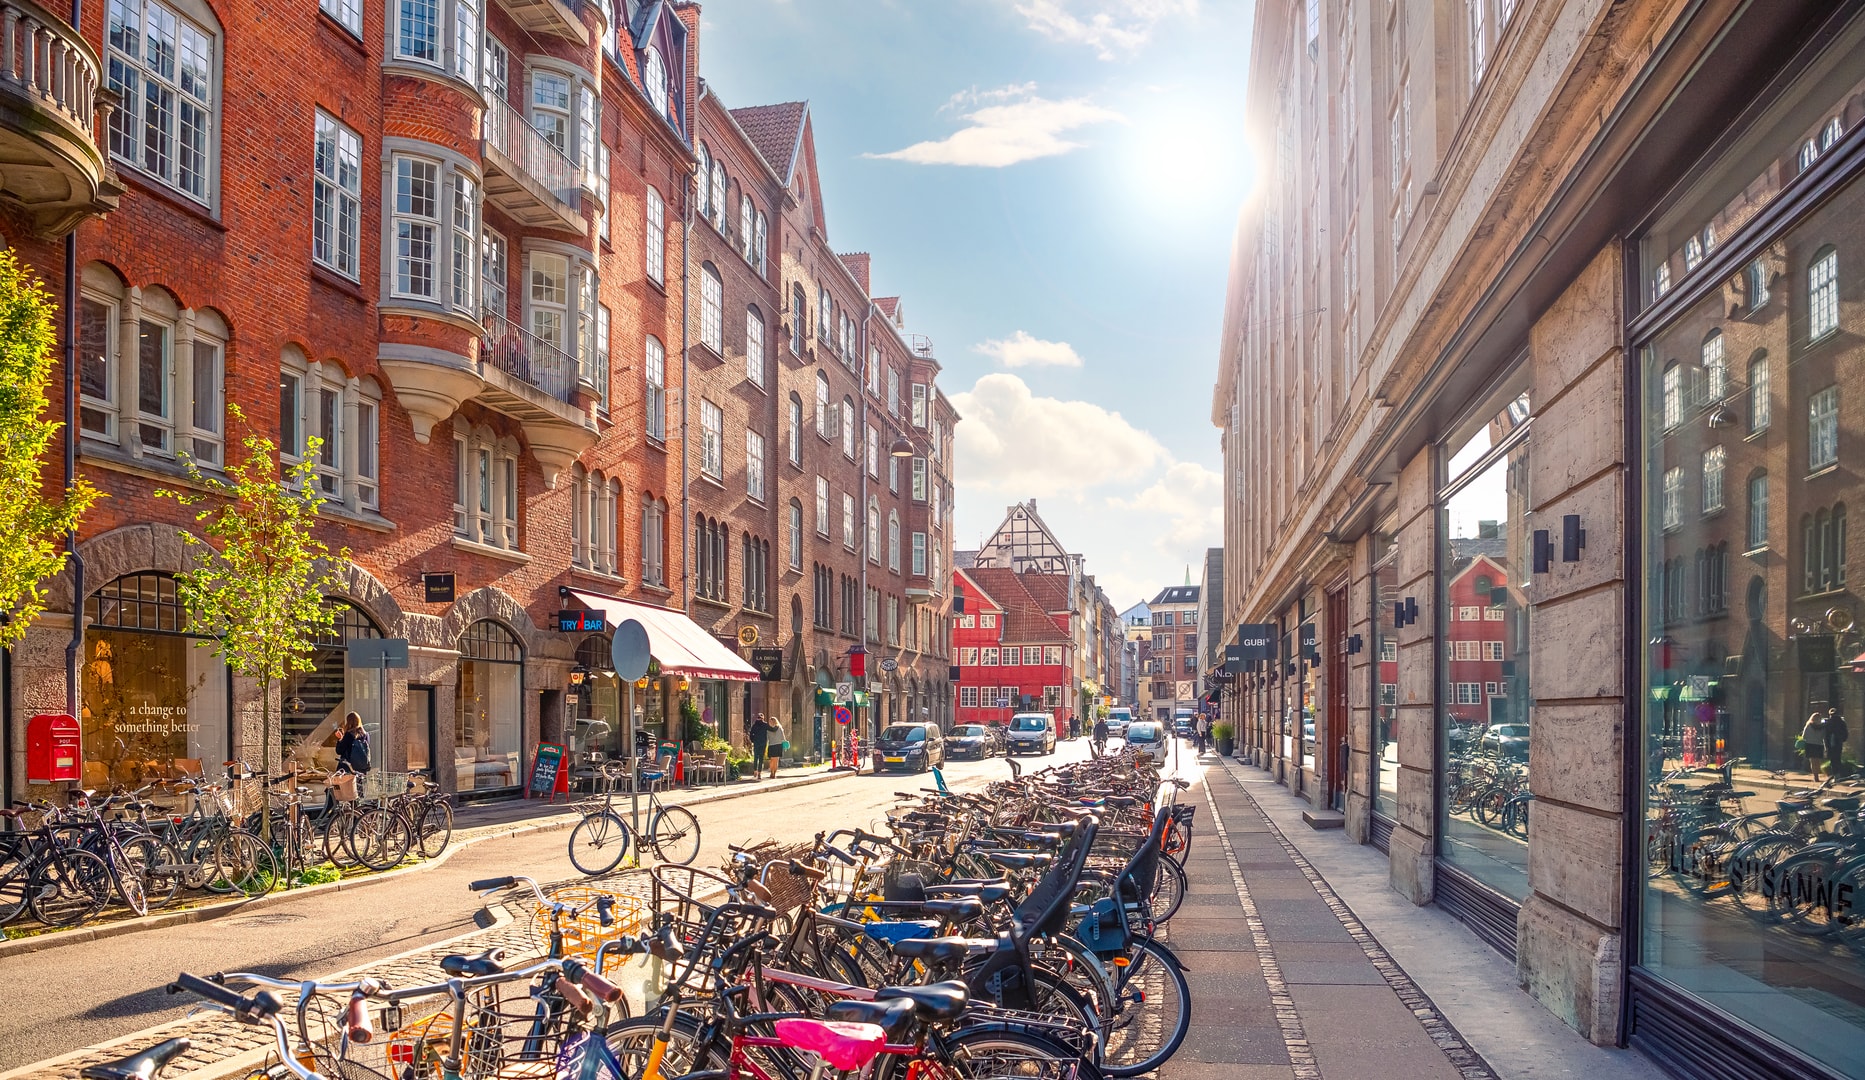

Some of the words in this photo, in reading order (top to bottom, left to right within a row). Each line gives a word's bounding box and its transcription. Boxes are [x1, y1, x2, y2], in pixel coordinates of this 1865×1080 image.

[1244, 638, 1265, 646] GUBI
[130, 707, 136, 715] a
[138, 701, 174, 719] change
[176, 706, 186, 715] to
[114, 719, 169, 737] something
[171, 719, 200, 733] better
[1731, 856, 1854, 925] SUSANNE
